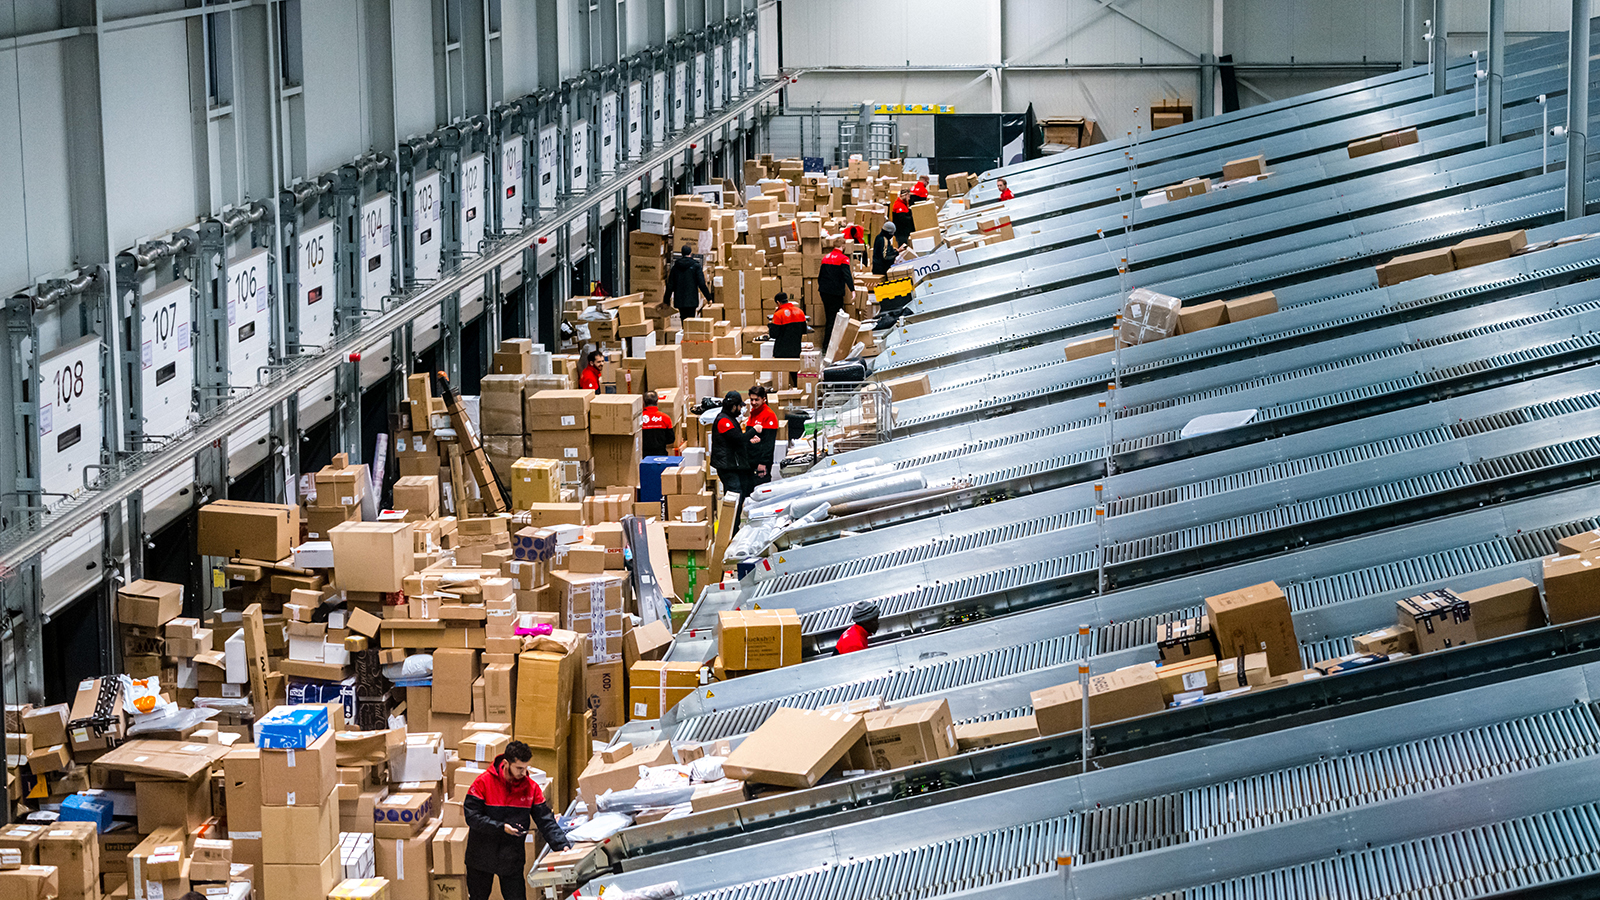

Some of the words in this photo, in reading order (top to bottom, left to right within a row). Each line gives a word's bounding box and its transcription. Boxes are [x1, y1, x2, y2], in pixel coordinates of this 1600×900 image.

[574, 131, 581, 154] 99
[505, 146, 517, 171] 101
[464, 165, 478, 193] 102
[417, 184, 433, 212] 103
[365, 206, 383, 239] 104
[305, 235, 325, 270] 105
[234, 265, 258, 305] 106
[151, 302, 177, 344] 107
[53, 360, 84, 407] 108
[651, 415, 663, 423] dpd
[602, 672, 612, 692] KOD:
[1031, 746, 1052, 755] GROUP
